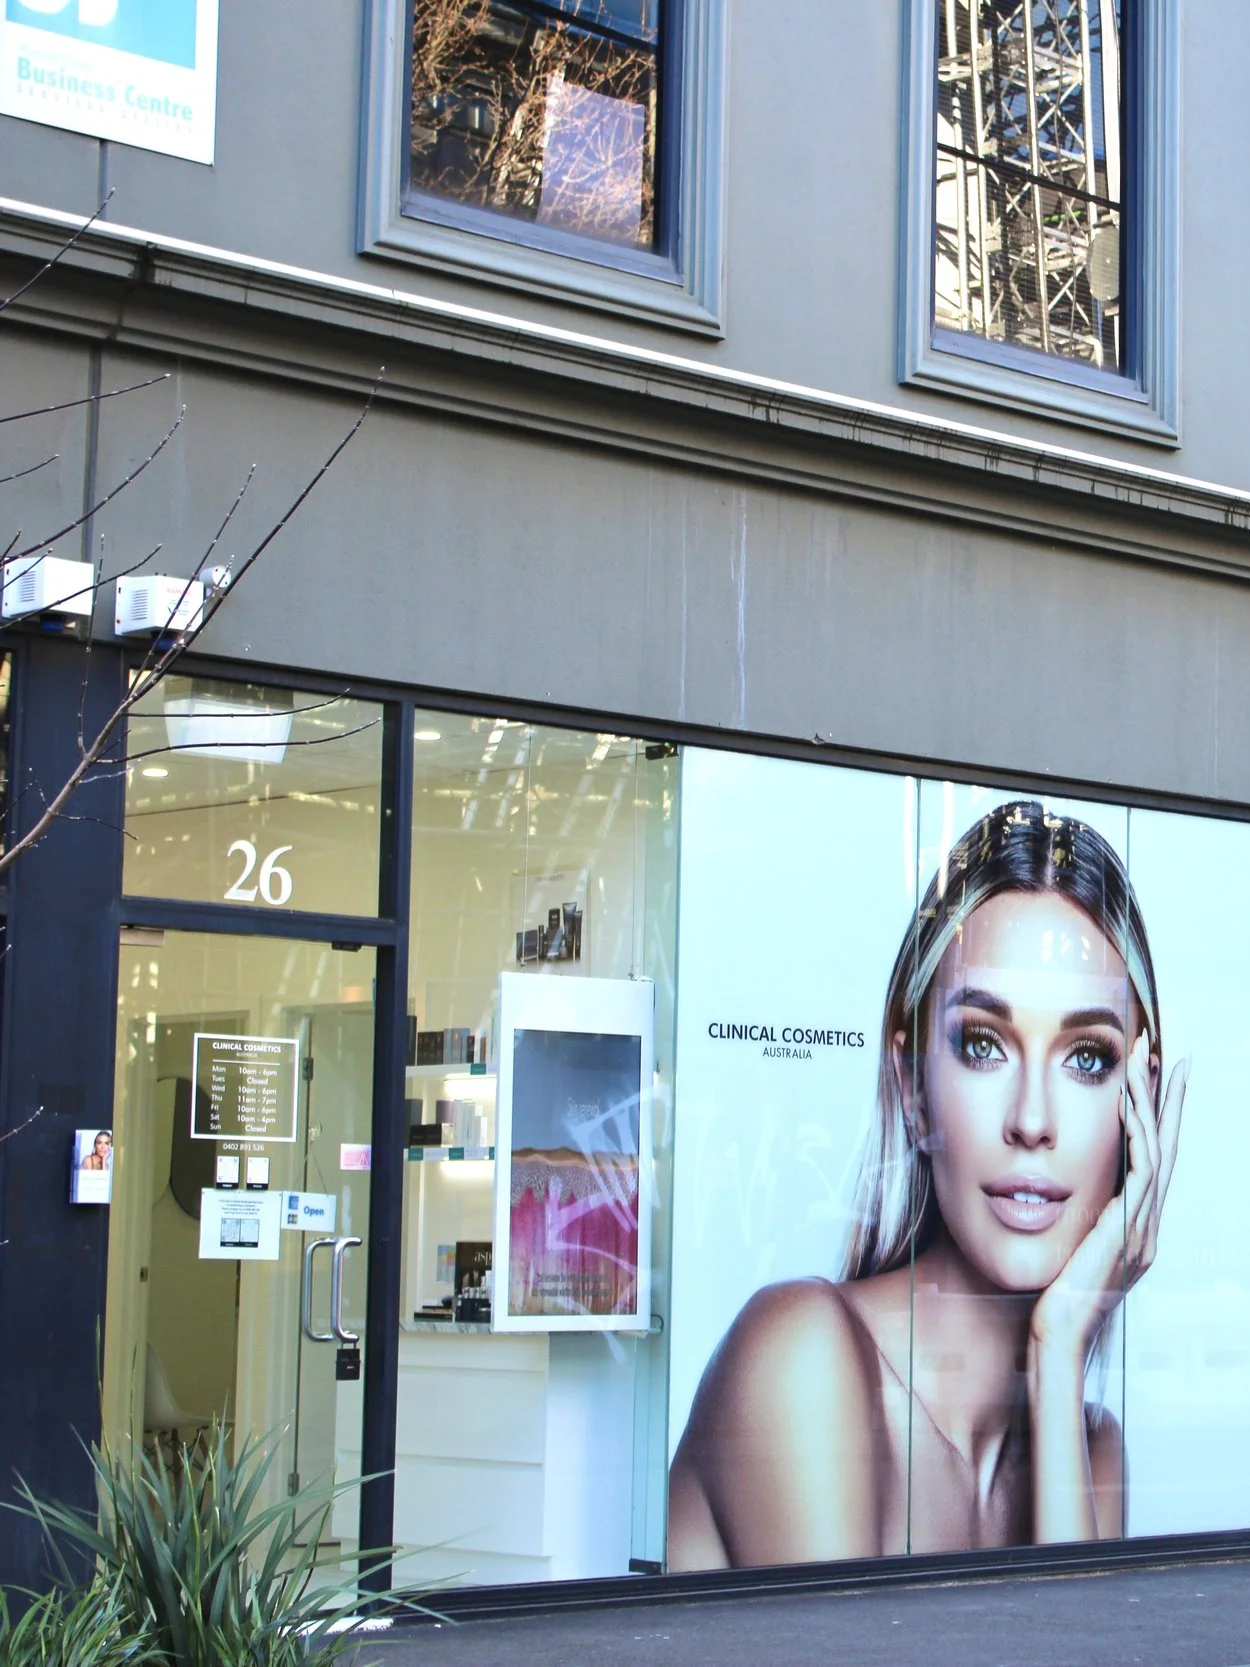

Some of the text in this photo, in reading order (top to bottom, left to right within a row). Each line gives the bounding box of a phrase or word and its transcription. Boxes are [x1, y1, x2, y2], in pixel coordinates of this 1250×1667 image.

[17, 56, 193, 121] Business Centre
[224, 839, 293, 906] 26
[708, 1023, 865, 1048] CLINICAL COSMETICS
[212, 1042, 281, 1053] CLINICAL COSMETICS
[762, 1046, 812, 1060] AUSTRALIA
[239, 1067, 256, 1075] 10am
[263, 1068, 277, 1077] 6pm
[247, 1077, 268, 1085] Closed
[238, 1086, 256, 1094] 10am
[262, 1087, 277, 1096] 6pm
[262, 1097, 276, 1105] 7pm
[238, 1105, 256, 1113] 10am
[262, 1106, 276, 1114] 6pm
[237, 1114, 256, 1122] 10am
[261, 1116, 276, 1124] 4pm
[303, 1206, 325, 1217] Open
